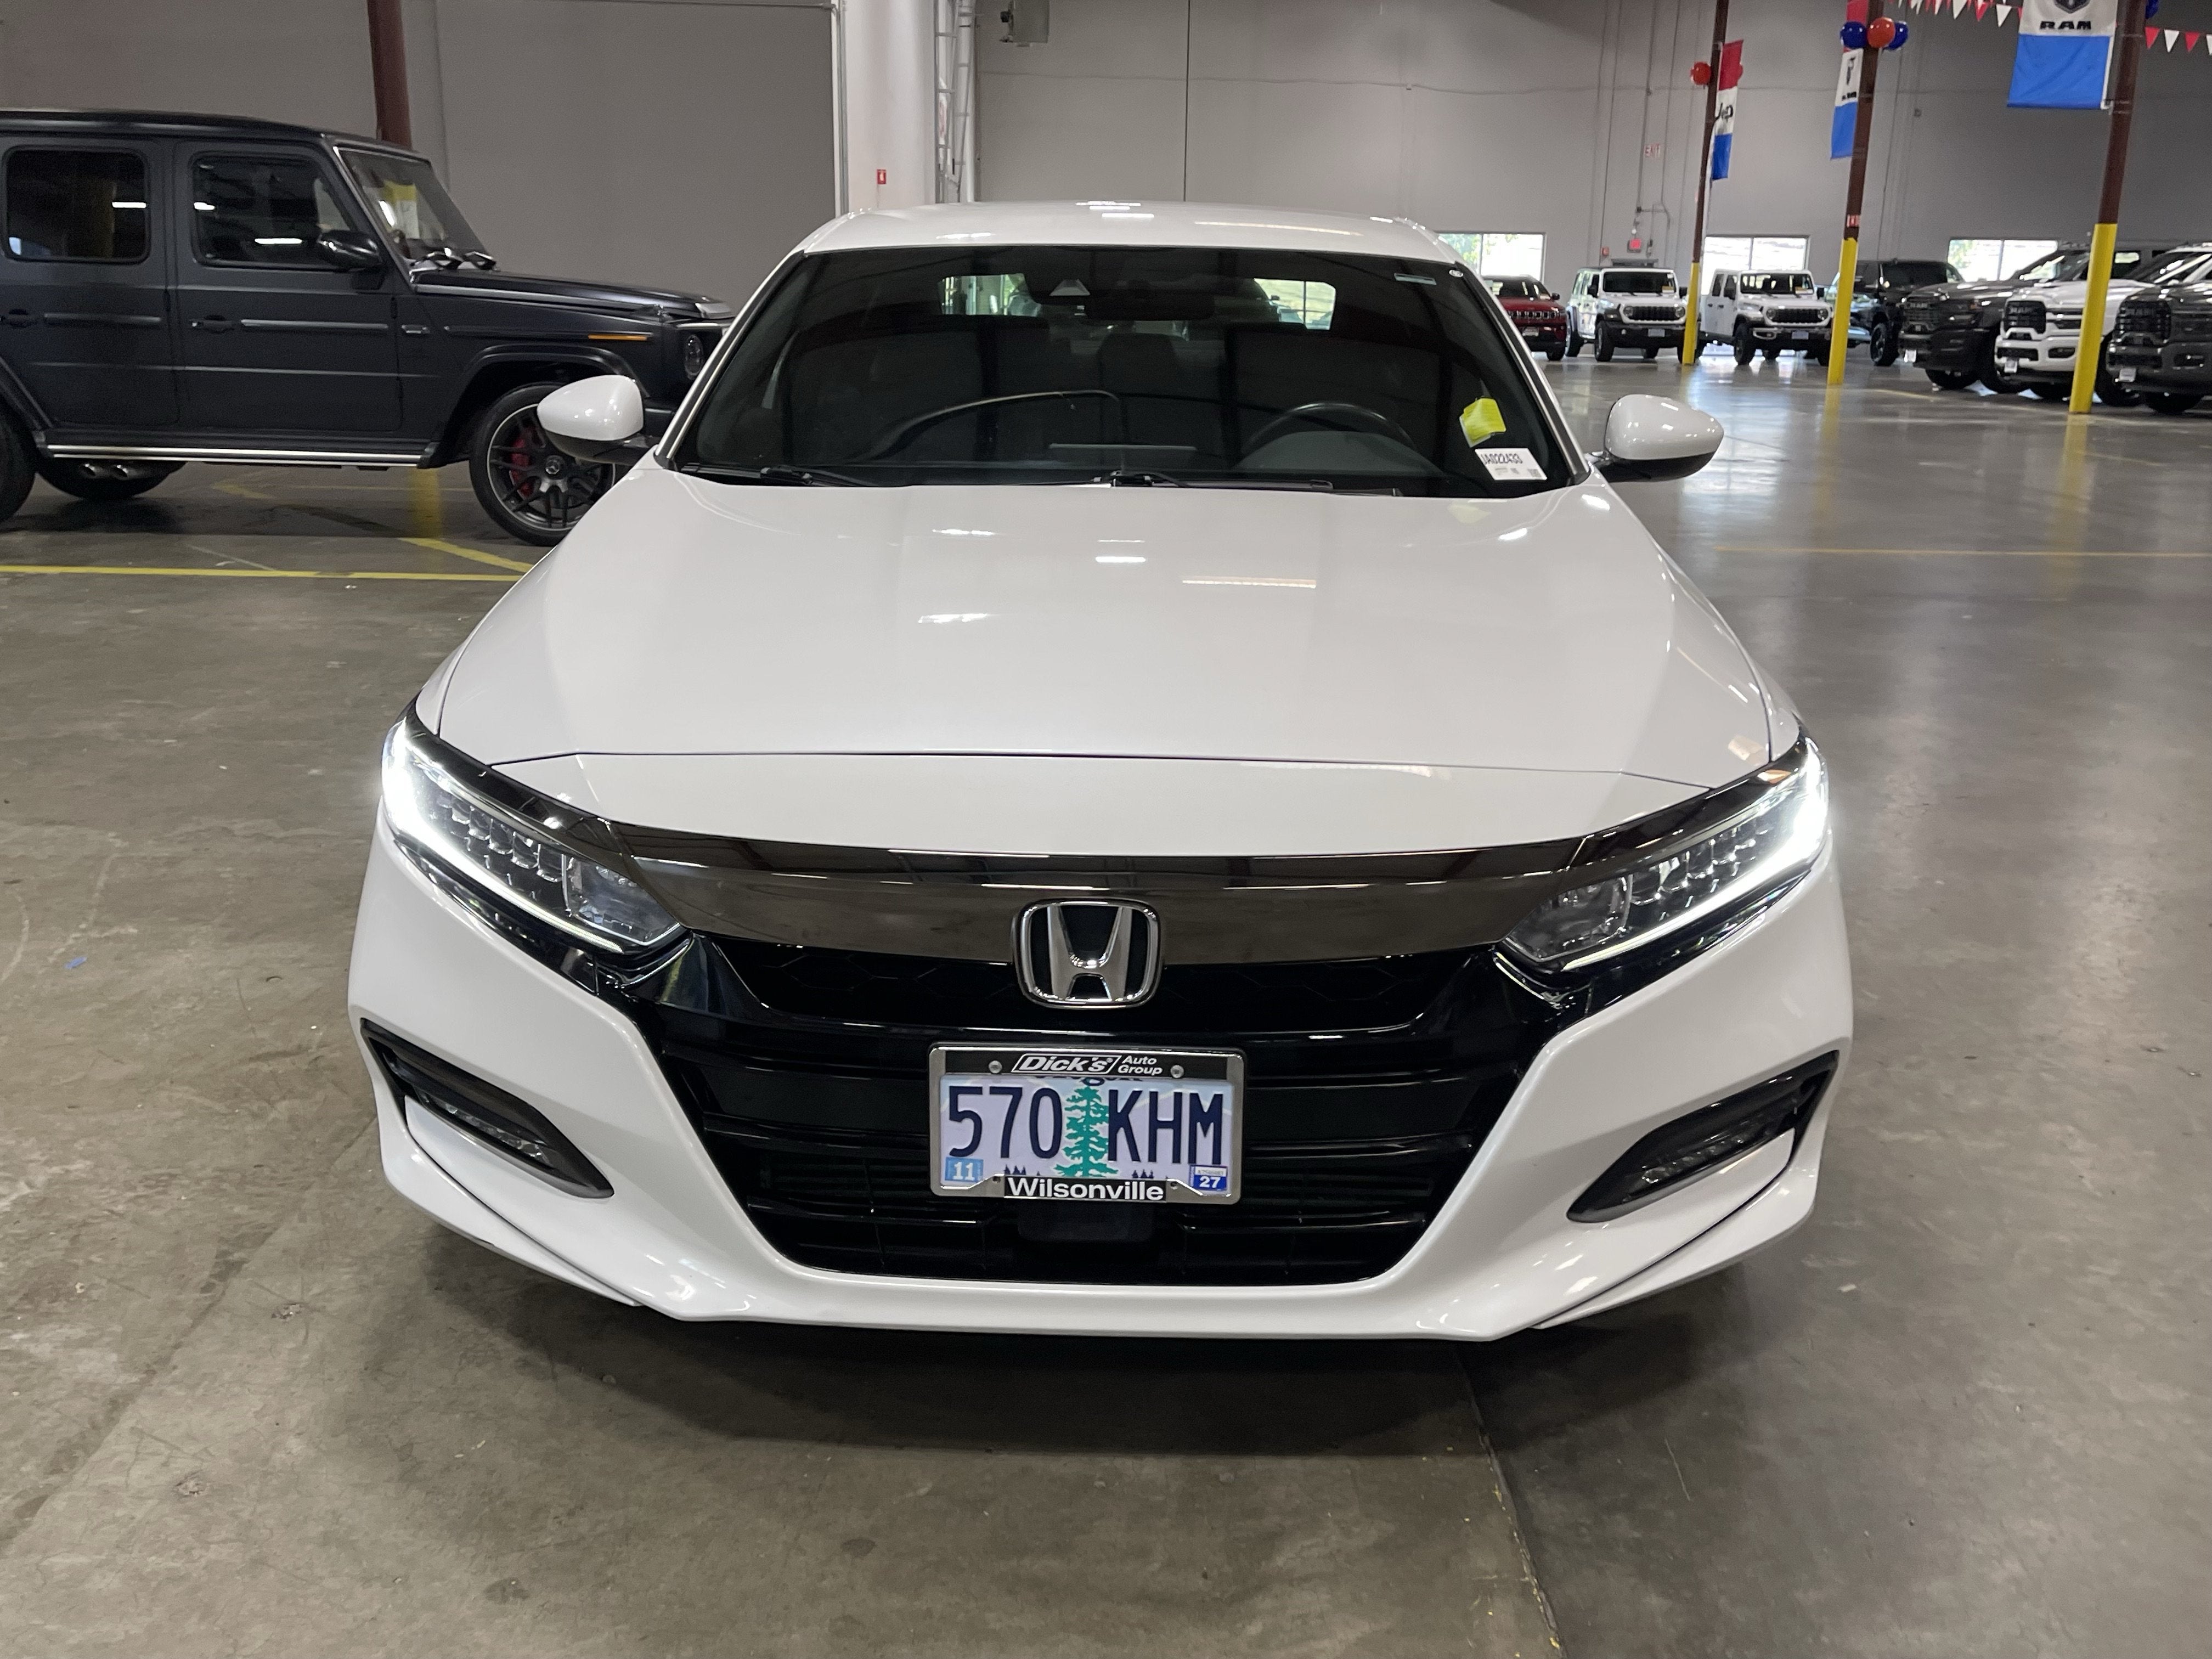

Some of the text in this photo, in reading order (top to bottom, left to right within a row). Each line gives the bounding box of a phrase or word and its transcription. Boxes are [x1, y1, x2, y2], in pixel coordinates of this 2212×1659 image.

[2040, 20, 2091, 30] RAM
[1018, 1056, 1107, 1073] Dick's
[1122, 1055, 1158, 1065] Auto
[1117, 1064, 1163, 1076] Group
[949, 1085, 1224, 1165] 570 KHM
[952, 1161, 975, 1181] 11
[1008, 1177, 1164, 1202] Wilsonville
[1199, 1176, 1222, 1189] 27
